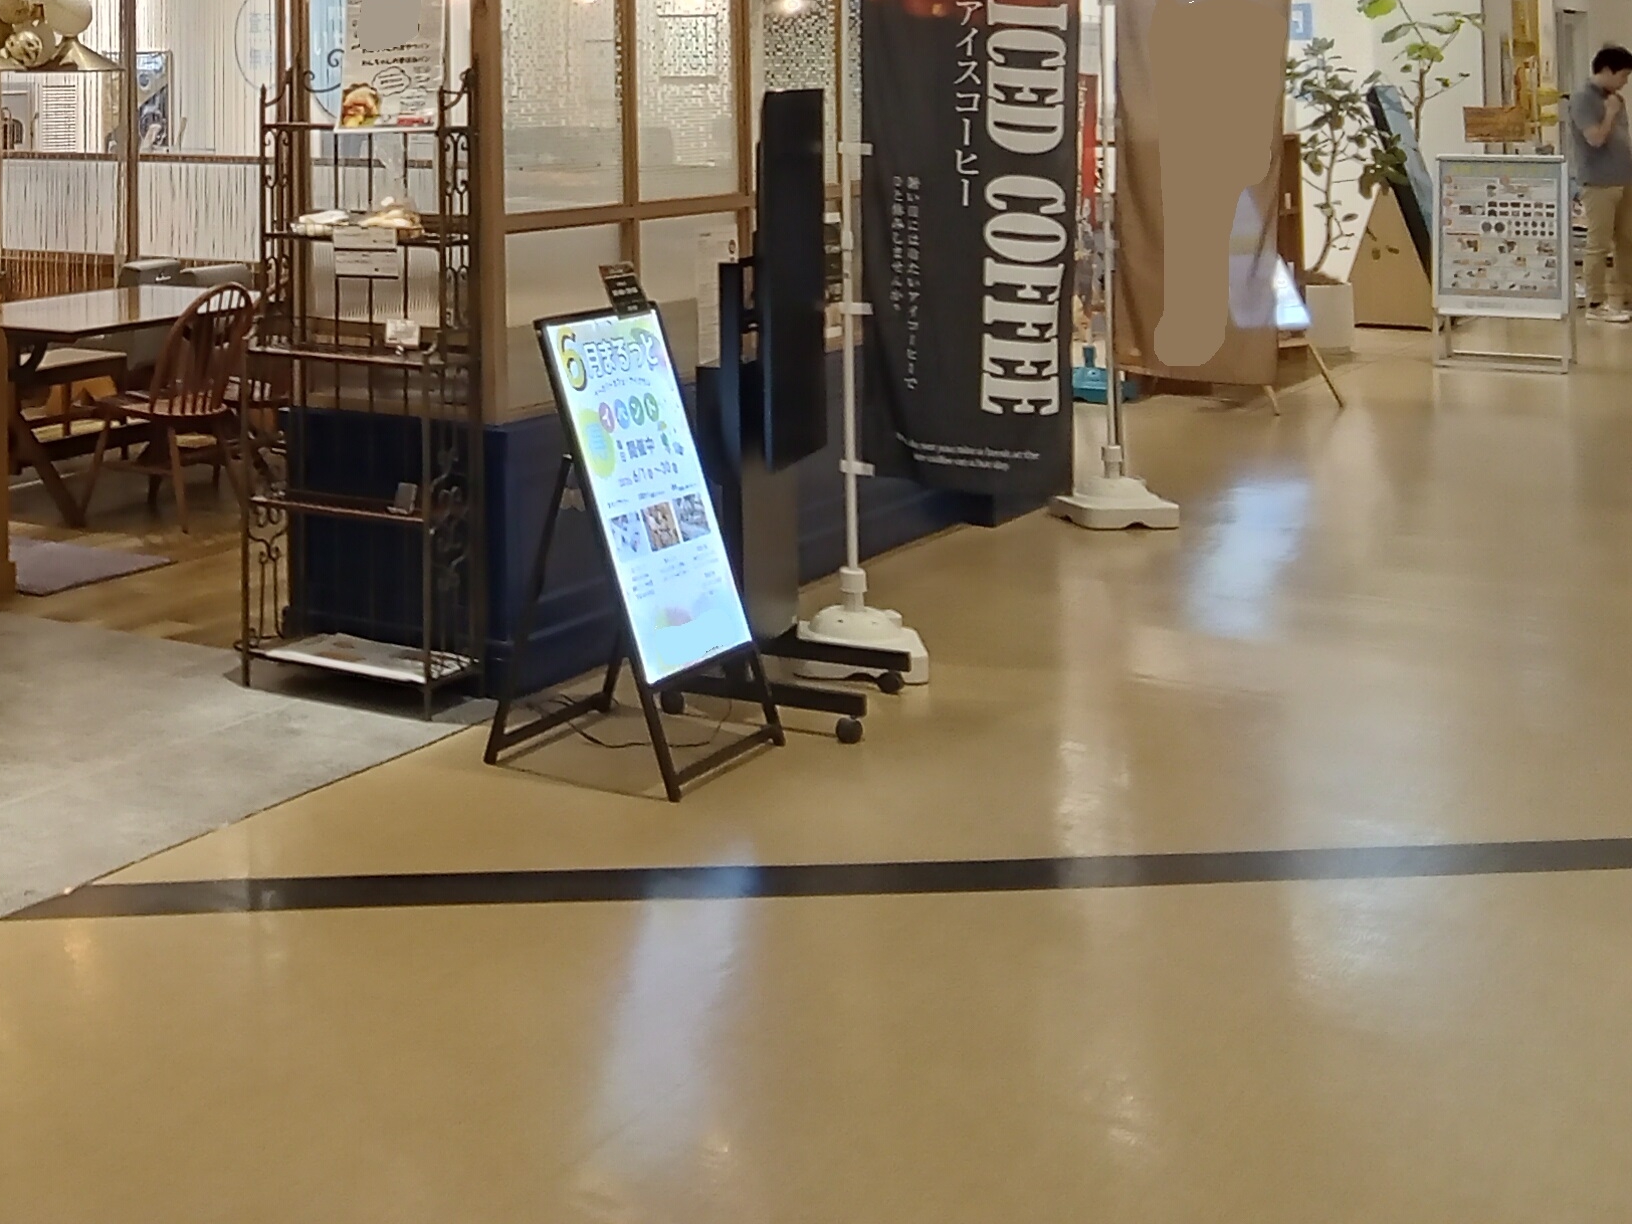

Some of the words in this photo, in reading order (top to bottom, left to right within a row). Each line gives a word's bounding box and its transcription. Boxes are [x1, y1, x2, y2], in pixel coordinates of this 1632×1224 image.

[954, 0, 983, 207] アイスコーヒー
[980, 174, 1067, 416] COFFEE
[600, 394, 659, 430] イベント
